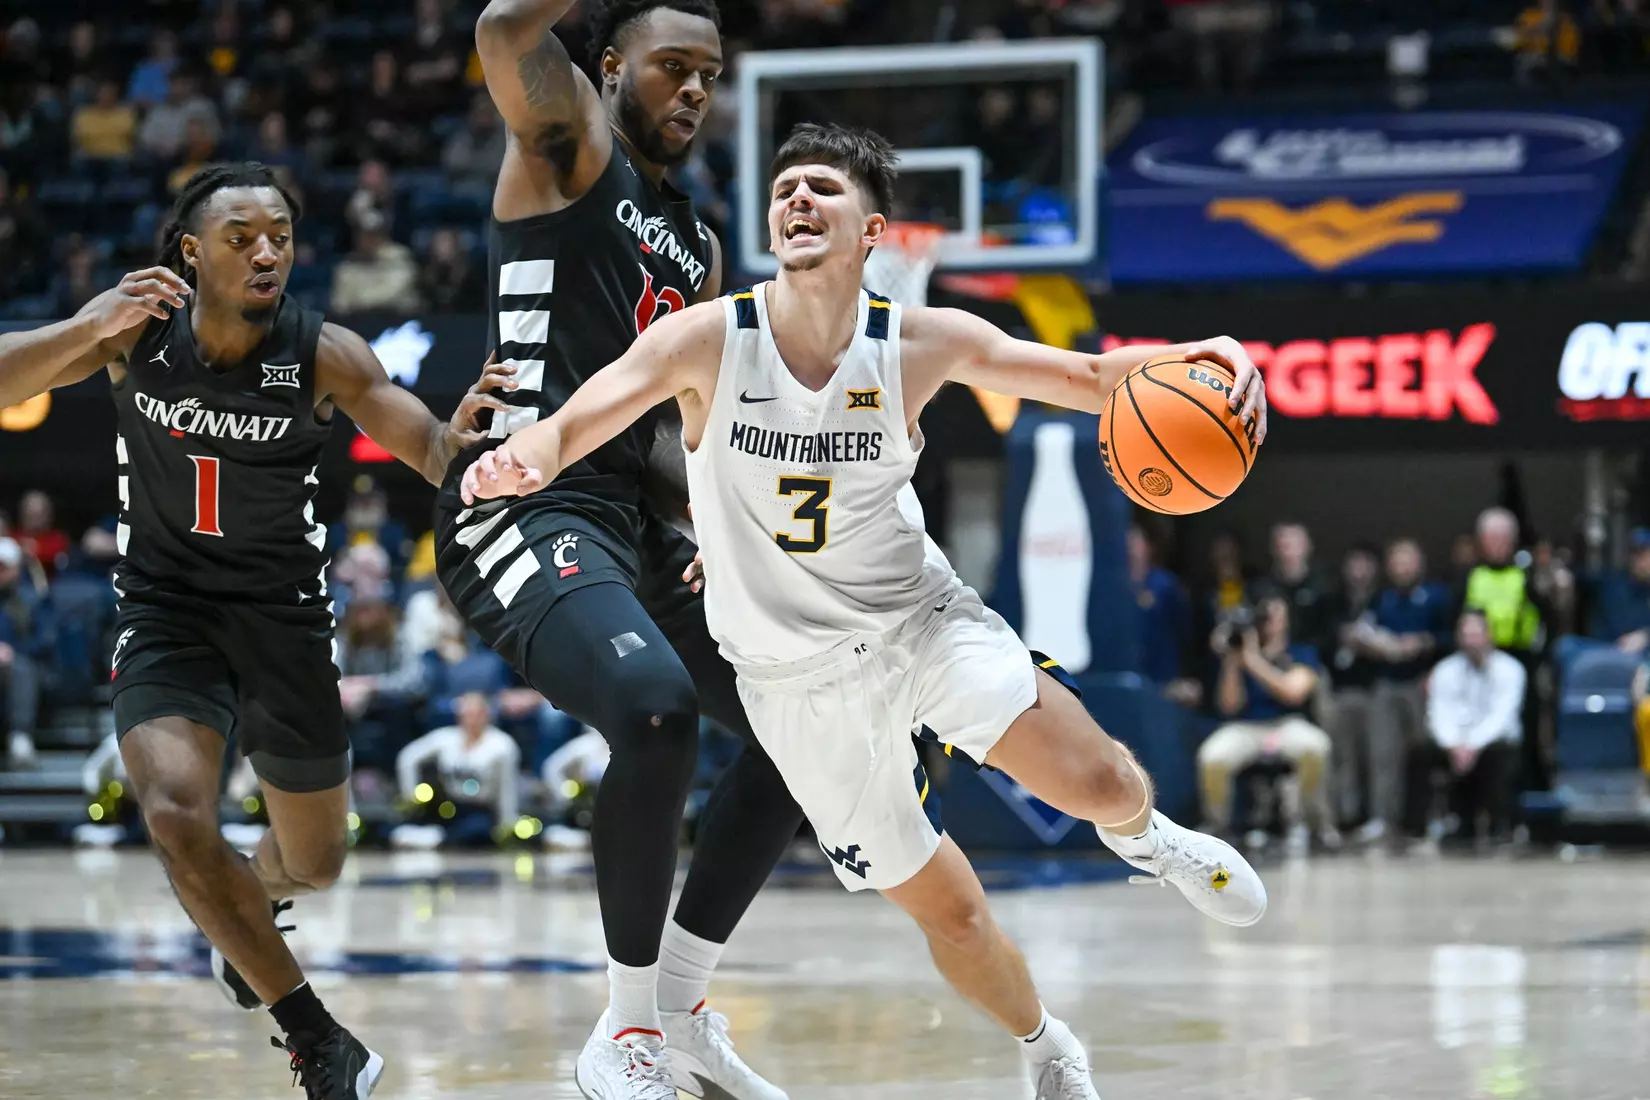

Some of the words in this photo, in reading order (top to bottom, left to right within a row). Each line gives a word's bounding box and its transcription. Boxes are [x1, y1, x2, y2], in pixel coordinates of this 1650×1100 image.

[616, 200, 705, 292] CINCINNATI
[134, 392, 293, 441] CINCINNATI
[846, 389, 882, 410] XII
[729, 421, 883, 464] MOUNTAINEERS
[186, 454, 224, 537] 1
[774, 475, 833, 554] 3
